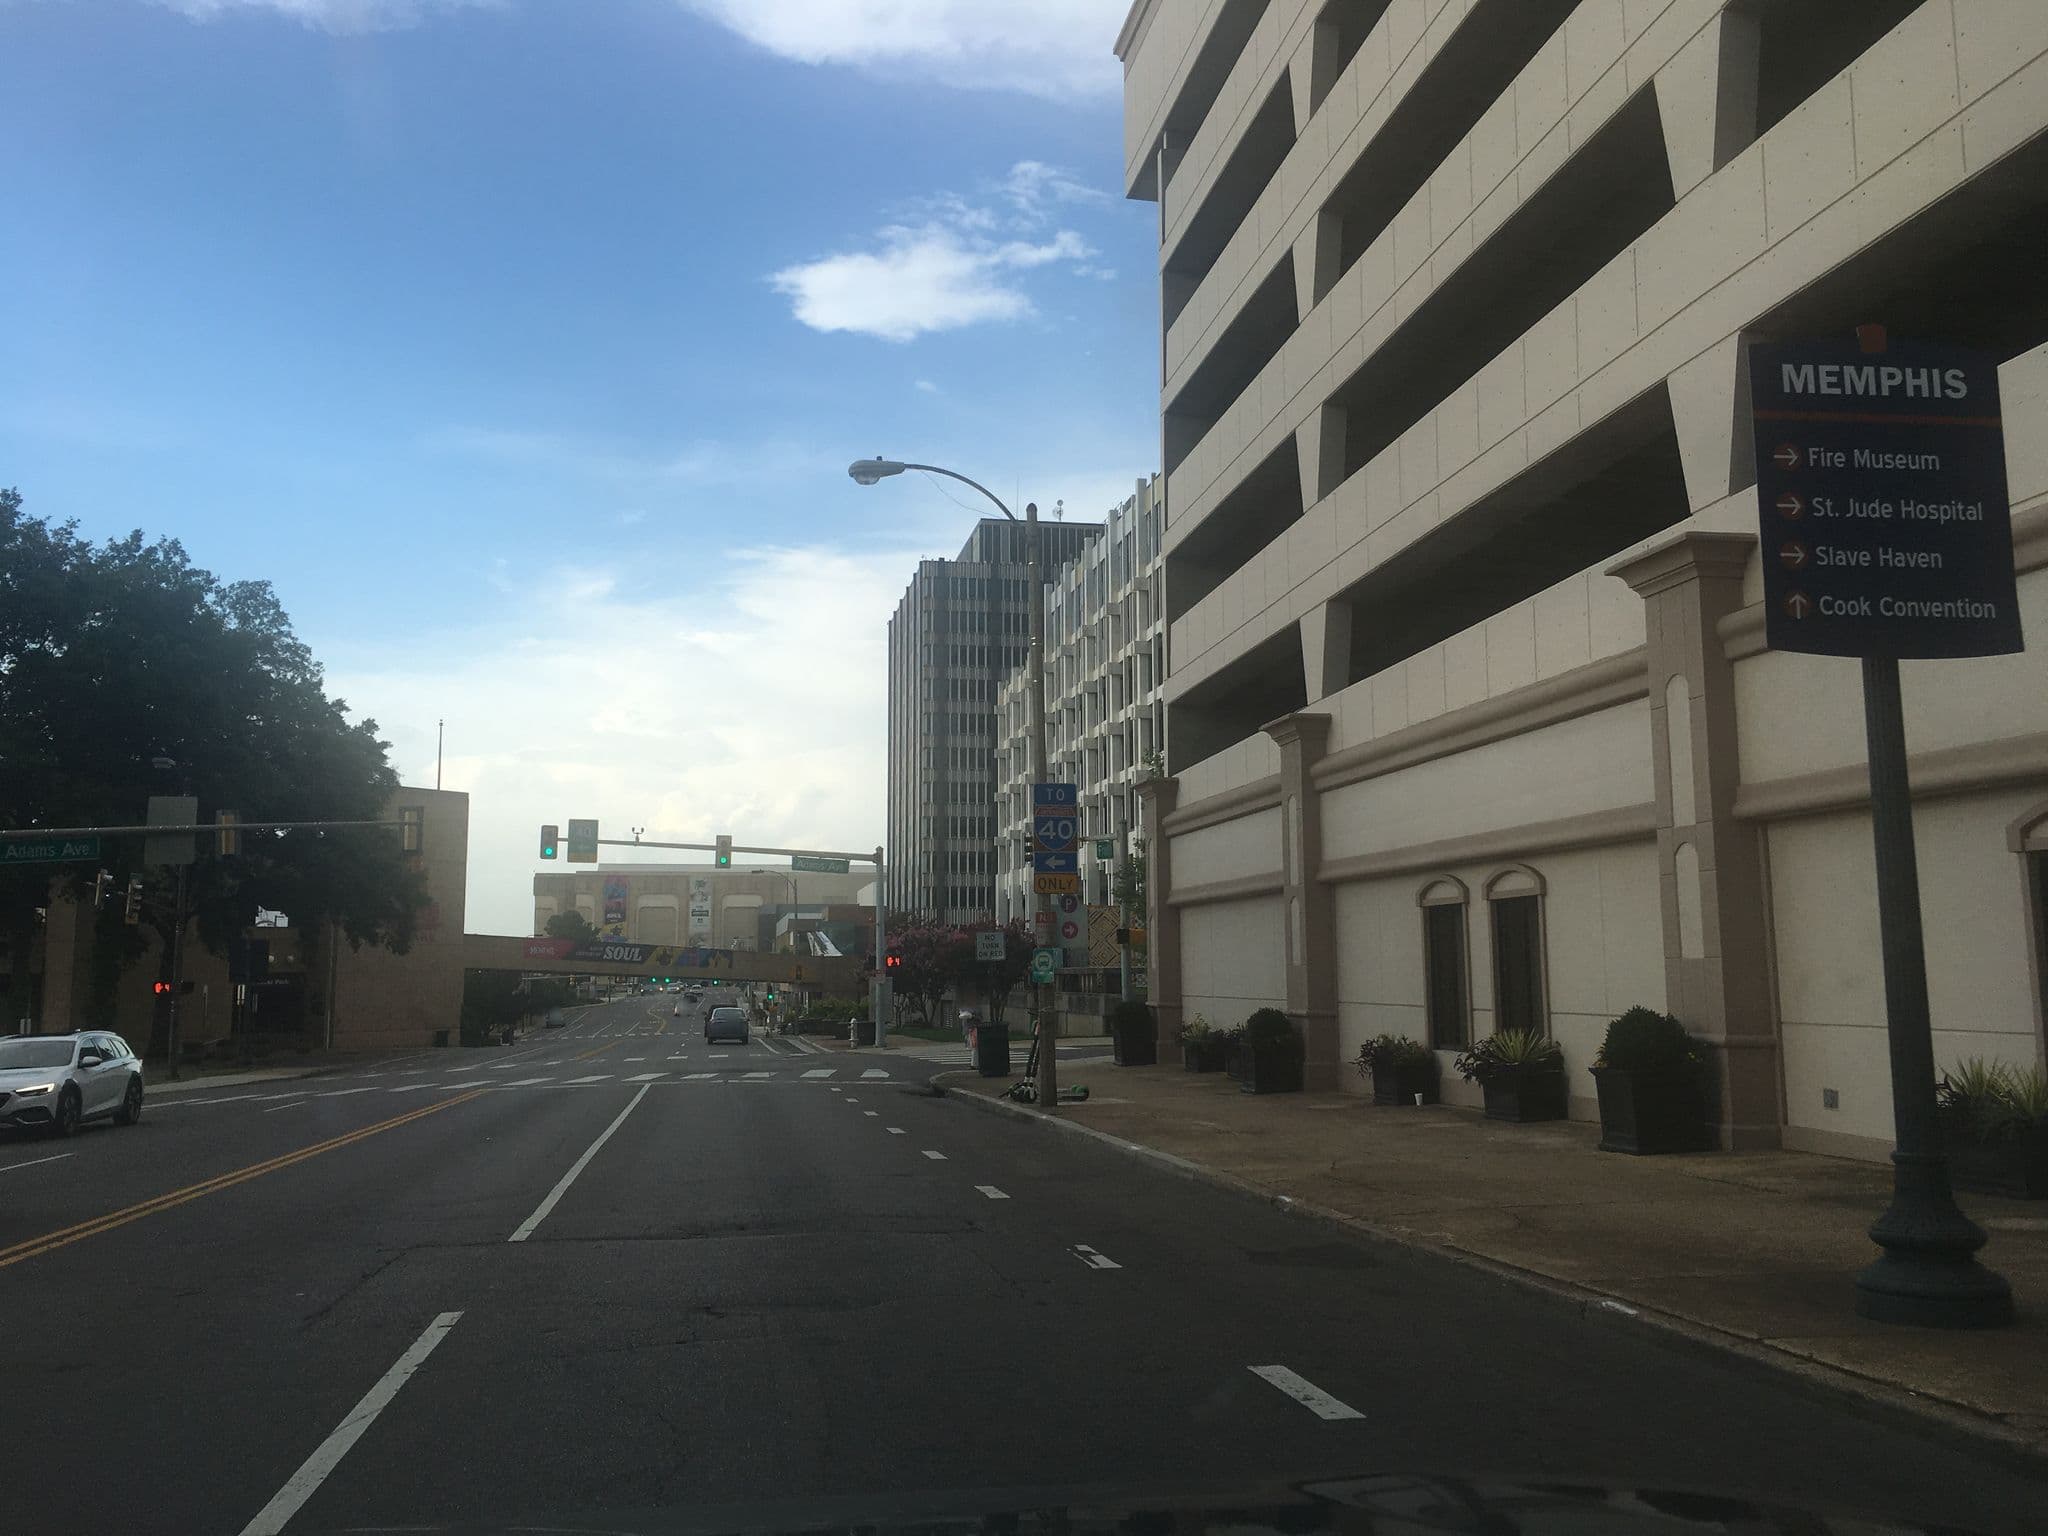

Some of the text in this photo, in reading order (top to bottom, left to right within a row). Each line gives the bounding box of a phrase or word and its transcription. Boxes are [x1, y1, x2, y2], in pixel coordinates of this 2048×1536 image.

[1781, 363, 1968, 399] MEMPHIS
[1808, 447, 1940, 470] Fire Museum
[1812, 497, 1983, 524] St. Jude Hospital
[1816, 546, 1942, 568] Slave Haven
[1819, 595, 1996, 619] Cook Convention
[1047, 788, 1065, 801] TO
[1038, 820, 1073, 840] 40
[6, 841, 89, 859] Adams Ave
[1038, 877, 1074, 890] ONLY
[1065, 899, 1073, 912] P
[603, 945, 642, 961] SOUL
